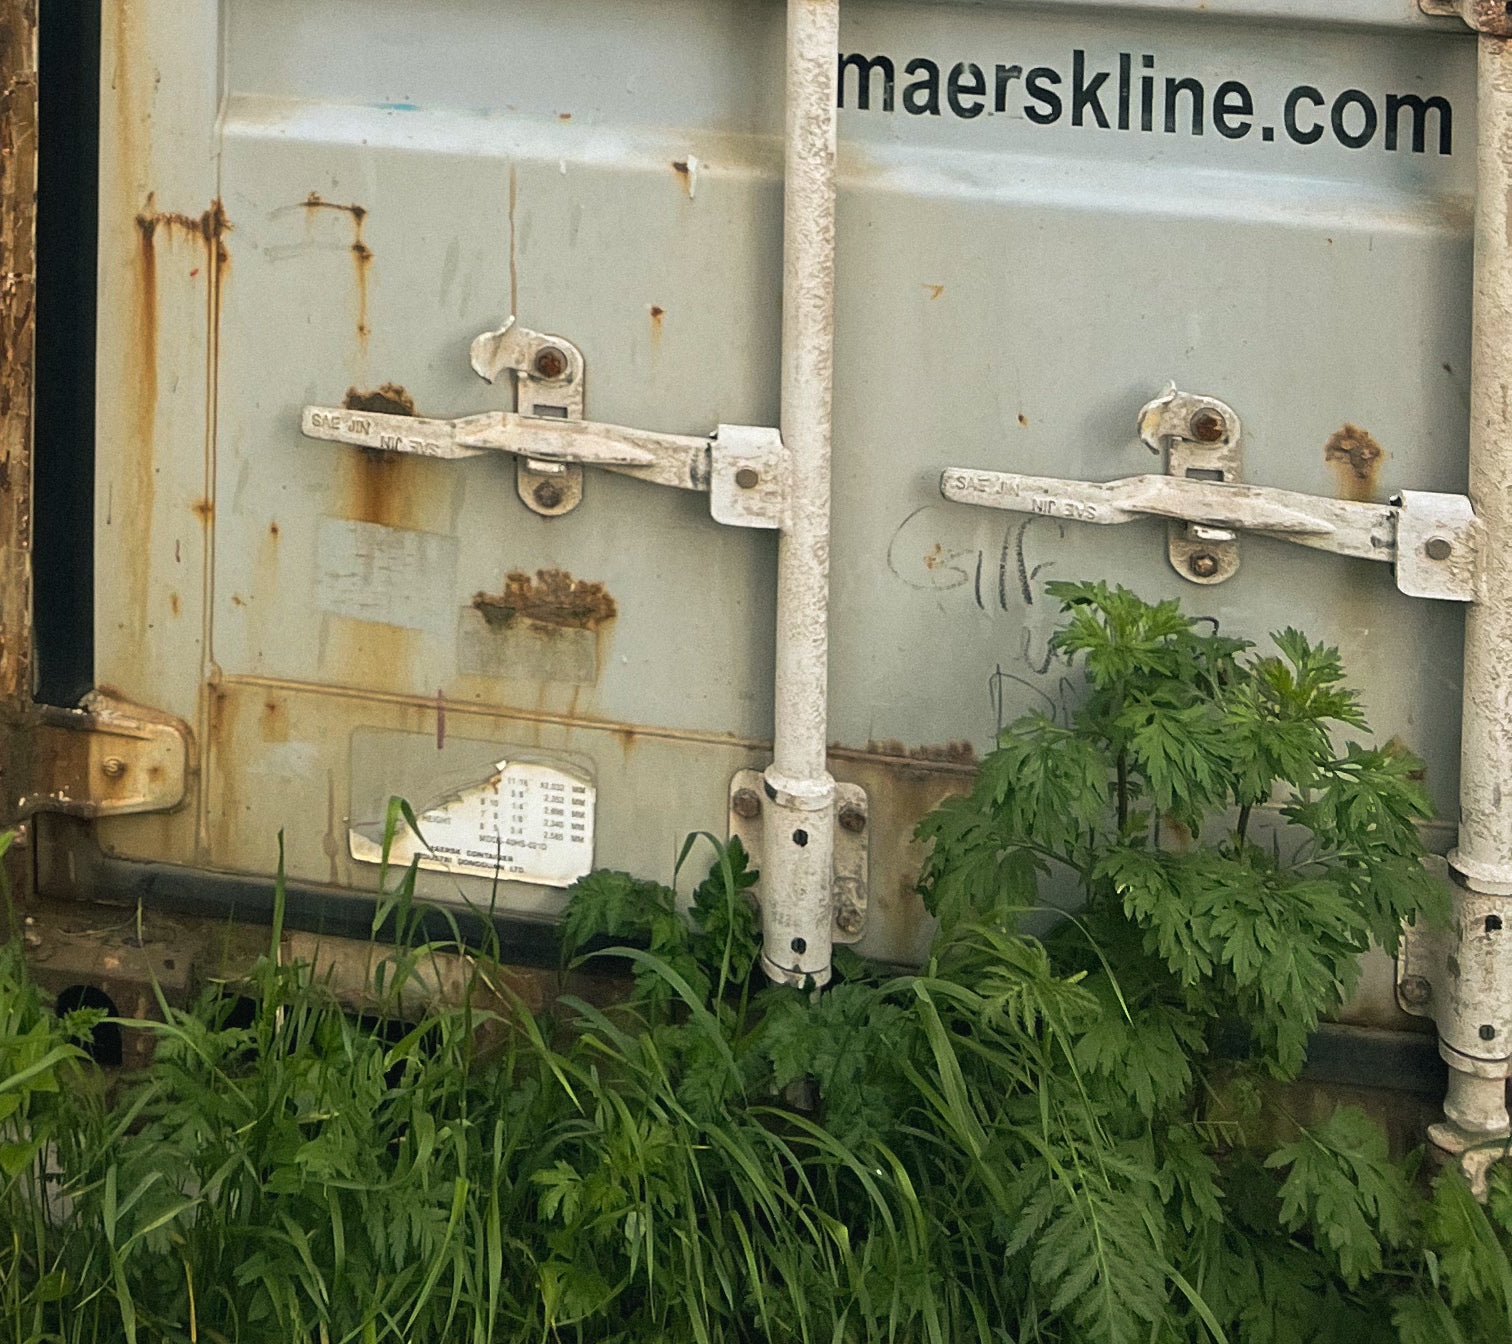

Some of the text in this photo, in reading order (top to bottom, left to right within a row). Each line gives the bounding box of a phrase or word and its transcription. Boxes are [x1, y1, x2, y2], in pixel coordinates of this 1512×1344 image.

[837, 49, 1454, 156] maerskline.com
[311, 413, 372, 436] SAE JIN
